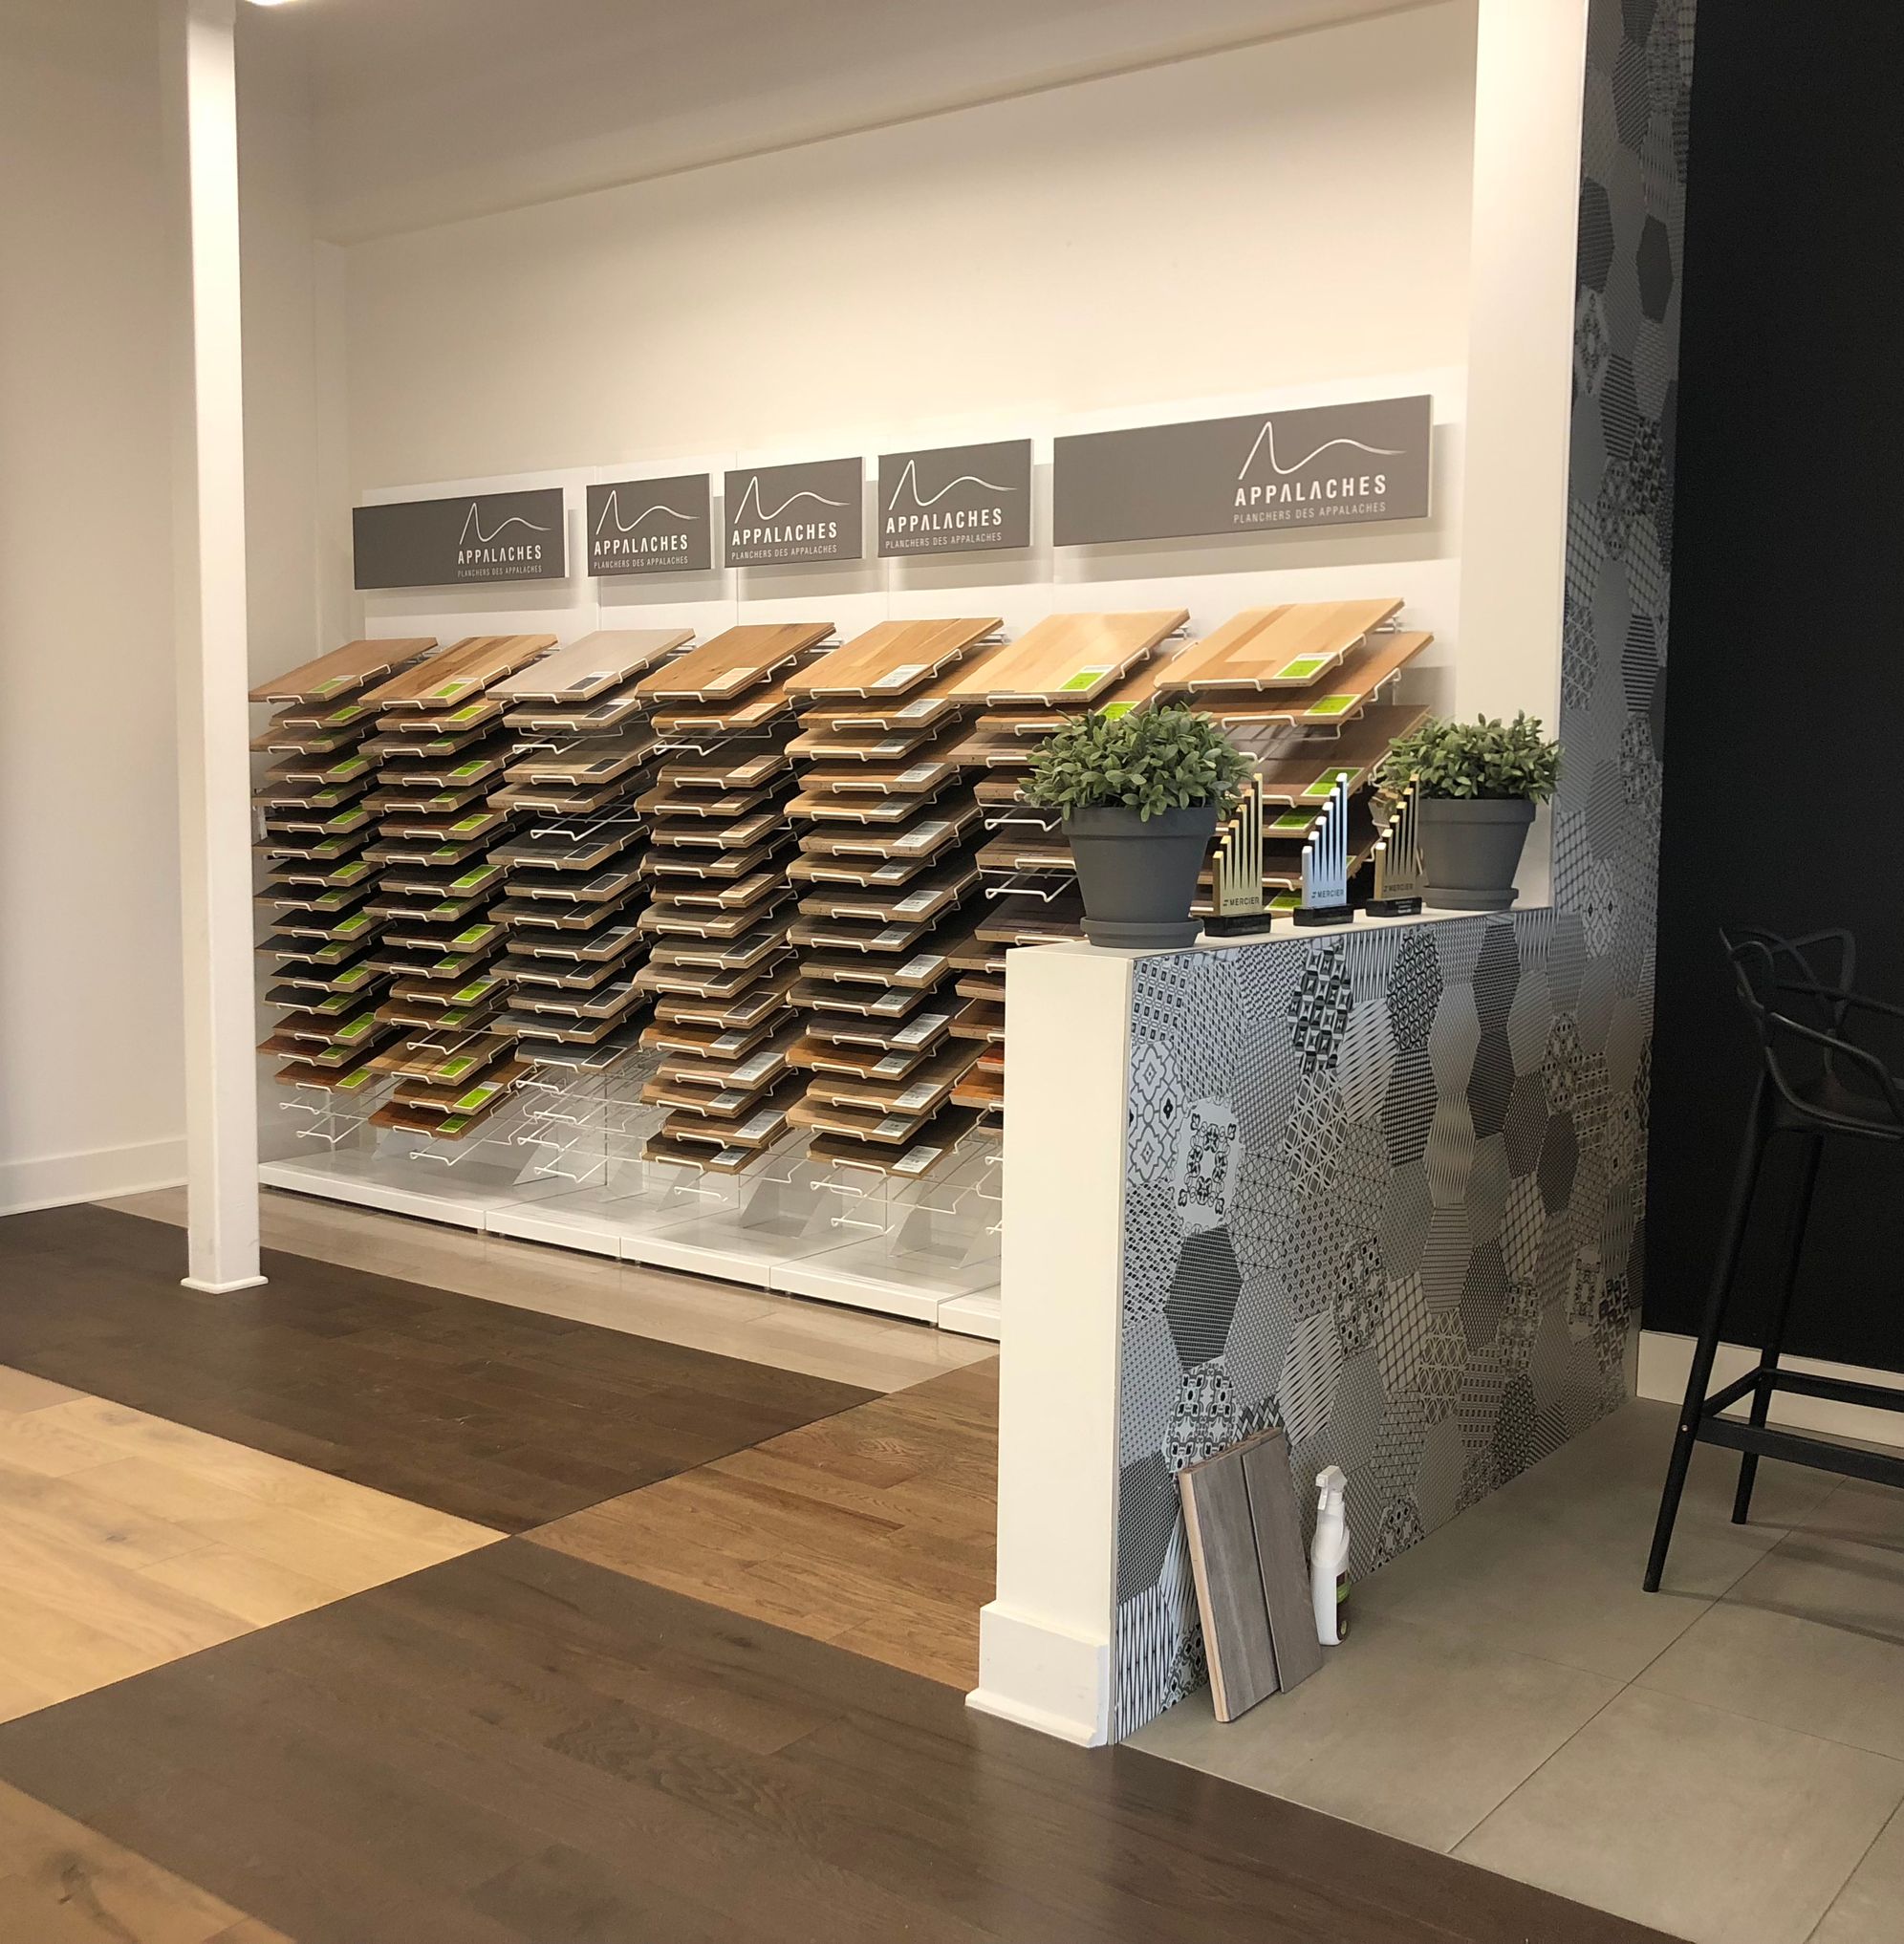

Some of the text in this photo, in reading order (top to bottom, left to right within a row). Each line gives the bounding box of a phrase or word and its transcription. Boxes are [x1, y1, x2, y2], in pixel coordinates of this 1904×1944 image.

[1234, 474, 1386, 507] APPALACHES
[886, 508, 1002, 533] APPALACHES
[1233, 502, 1386, 524] PLANCHERS DES APPALACHES
[731, 521, 837, 546] APPALACHES
[885, 531, 1002, 549] PLANCHERS DES APPALACHES
[458, 544, 542, 565] APPALACHES
[594, 534, 688, 555] APPALACHES
[731, 544, 837, 560] PLANCHERS DES APPALACHES
[594, 555, 688, 570] PLANCHERS DES APPALACHES
[1229, 896, 1260, 906] MERCIER
